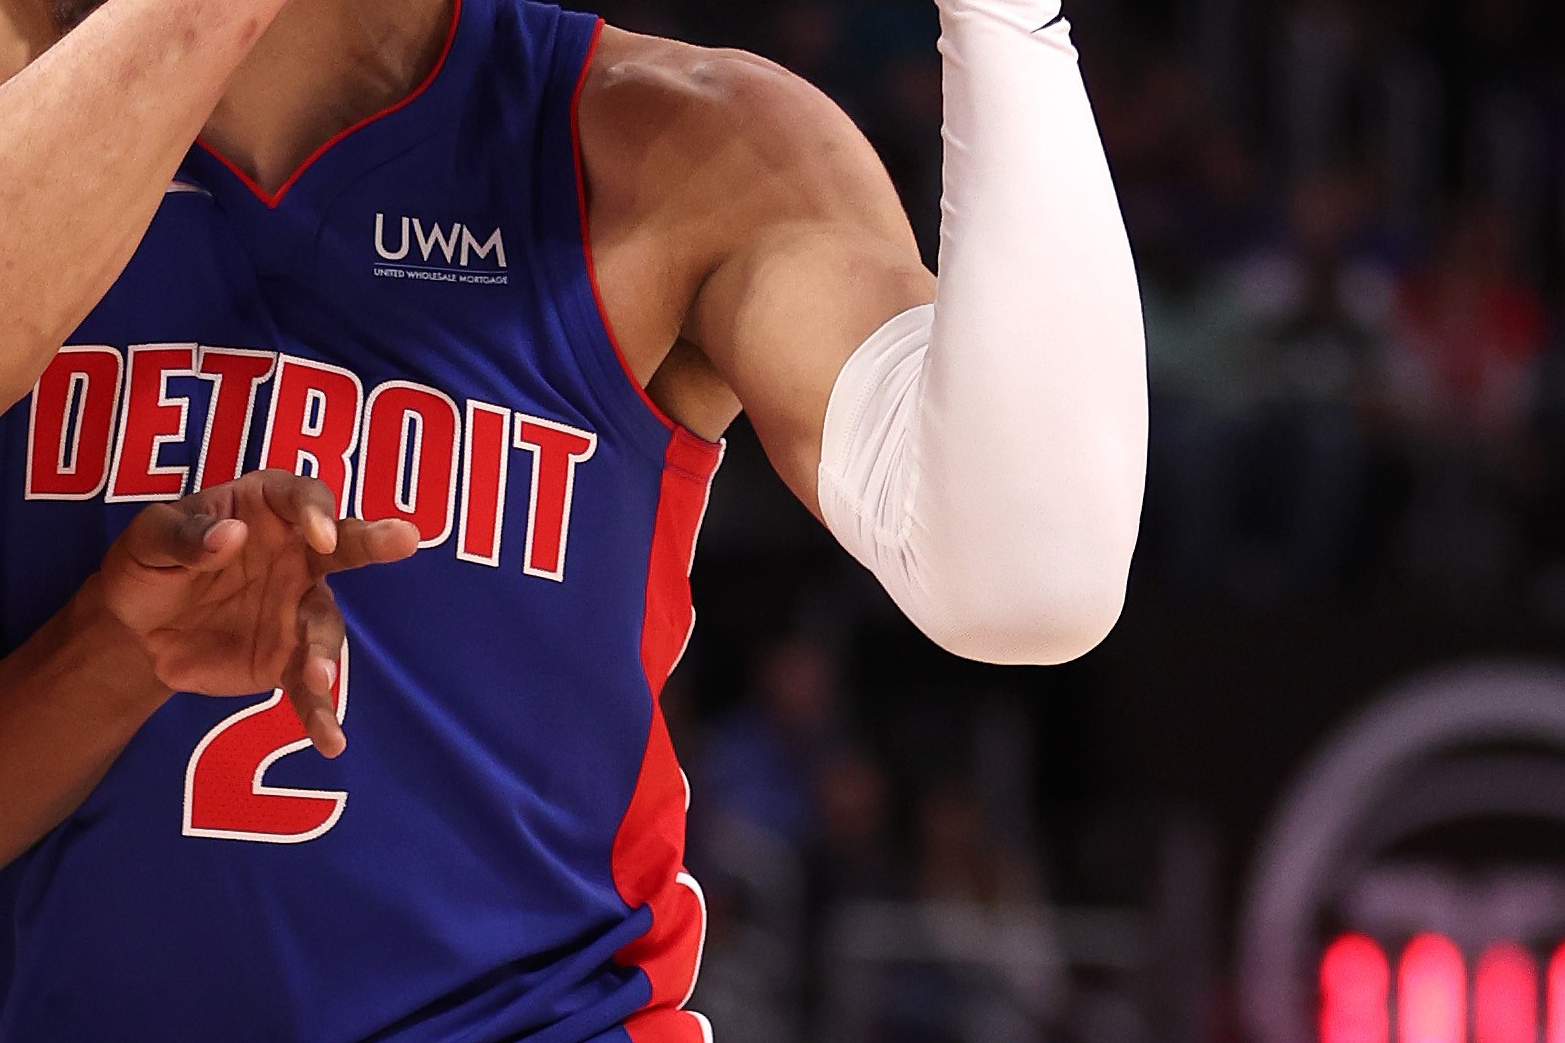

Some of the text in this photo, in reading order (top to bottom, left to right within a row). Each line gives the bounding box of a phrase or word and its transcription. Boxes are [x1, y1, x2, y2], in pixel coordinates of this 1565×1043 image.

[373, 212, 507, 268] UWM
[373, 267, 508, 286] UNITED WHOLESALE MORTGAGE
[24, 342, 598, 583] DETROIT
[181, 631, 350, 844] 2
